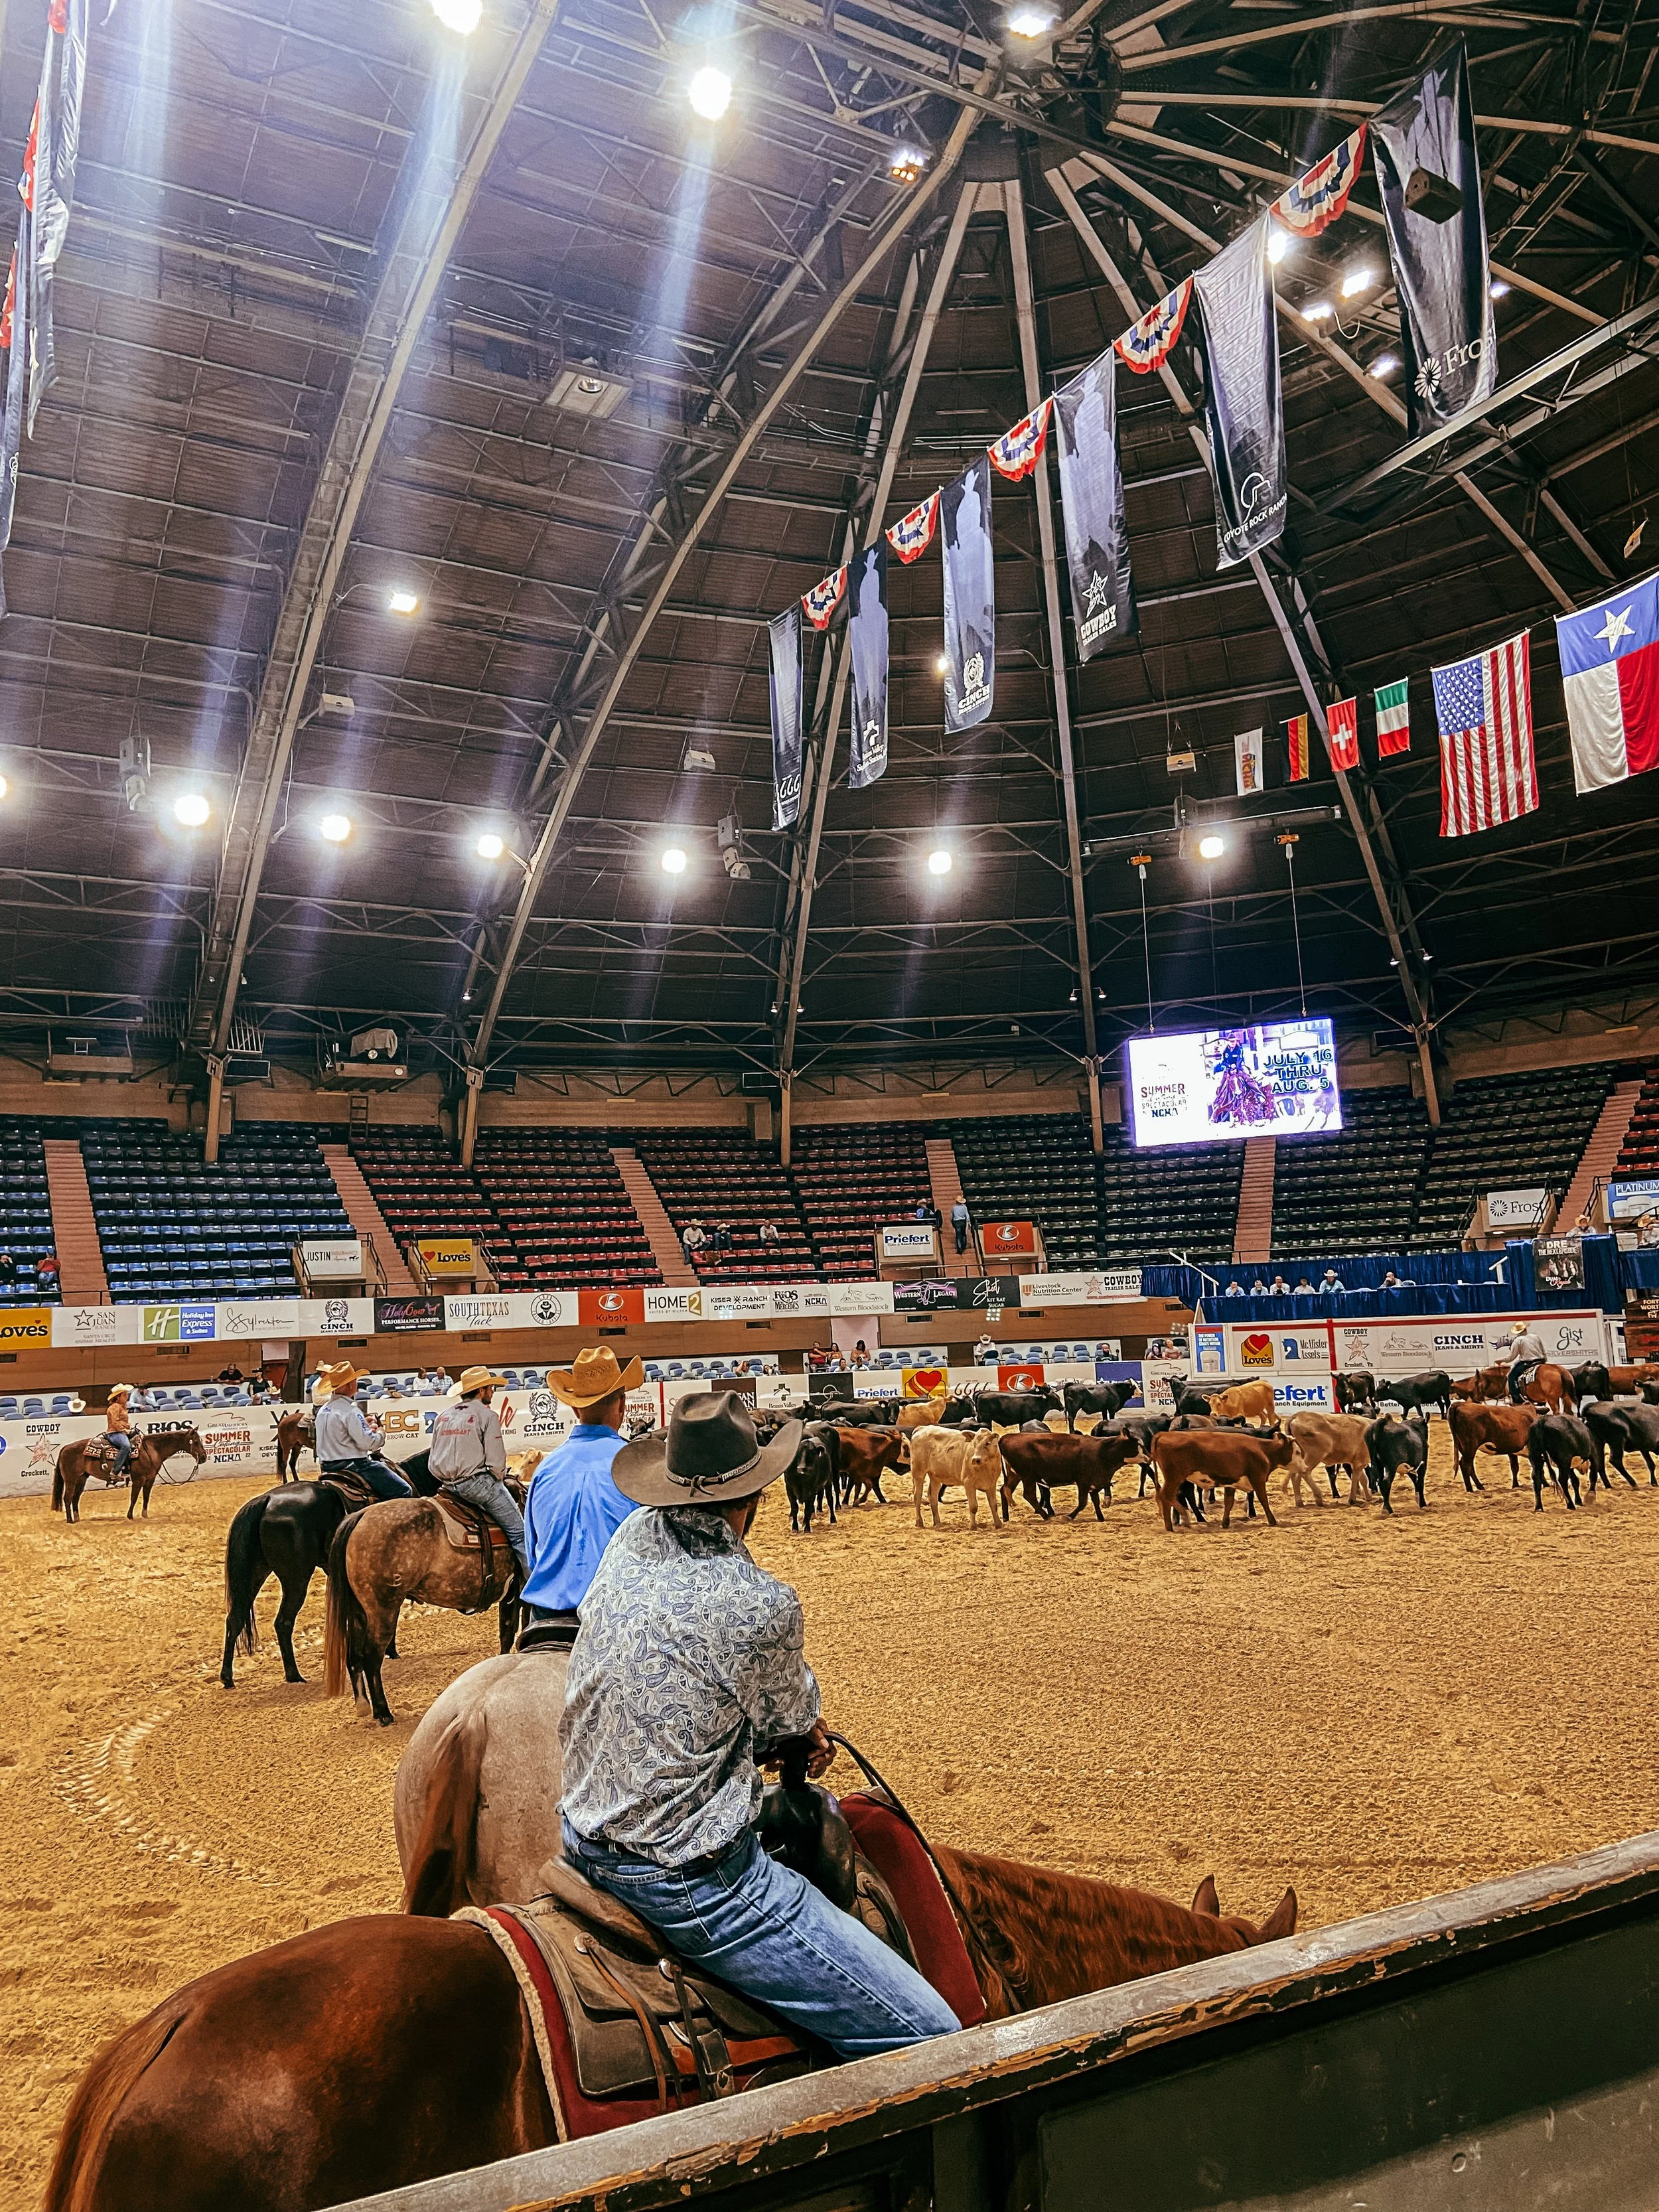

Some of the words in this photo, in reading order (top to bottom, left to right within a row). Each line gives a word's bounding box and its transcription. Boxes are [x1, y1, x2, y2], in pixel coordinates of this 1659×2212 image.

[1224, 522, 1250, 543] COYOTE
[1249, 510, 1268, 528] ROCK
[1268, 492, 1287, 516] RANCH
[1080, 604, 1116, 640] COWBOY
[958, 684, 990, 709] CINCH
[1263, 1051, 1305, 1067] JULY
[1313, 1049, 1332, 1063] 16
[1274, 1063, 1323, 1078] THRU
[1141, 1083, 1185, 1098] SUMMER
[1271, 1078, 1313, 1094] AUG.
[1319, 1076, 1329, 1089] 5
[1615, 1181, 1659, 1194] PLATINUM
[885, 1234, 930, 1243] Priefert
[1546, 1240, 1568, 1248] DRE
[305, 1251, 331, 1262] JUSTIN
[1104, 1275, 1141, 1286] COWBOY
[92, 1318, 116, 1327] JUAN
[181, 1319, 214, 1328] Express
[467, 1314, 492, 1327] Tack
[1434, 1335, 1484, 1345] CINCH
[1557, 1327, 1583, 1351] Gist
[1301, 1350, 1321, 1359] Assets
[857, 1388, 899, 1397] Priefert
[1273, 1385, 1326, 1400] efert
[625, 1403, 654, 1412] UMMER
[26, 1424, 61, 1433] COWBOY
[524, 1422, 564, 1432] CINCH
[205, 1430, 251, 1444] SUMMER
[205, 1445, 251, 1455] SPECTACULAR
[214, 1453, 242, 1463] NCHA
